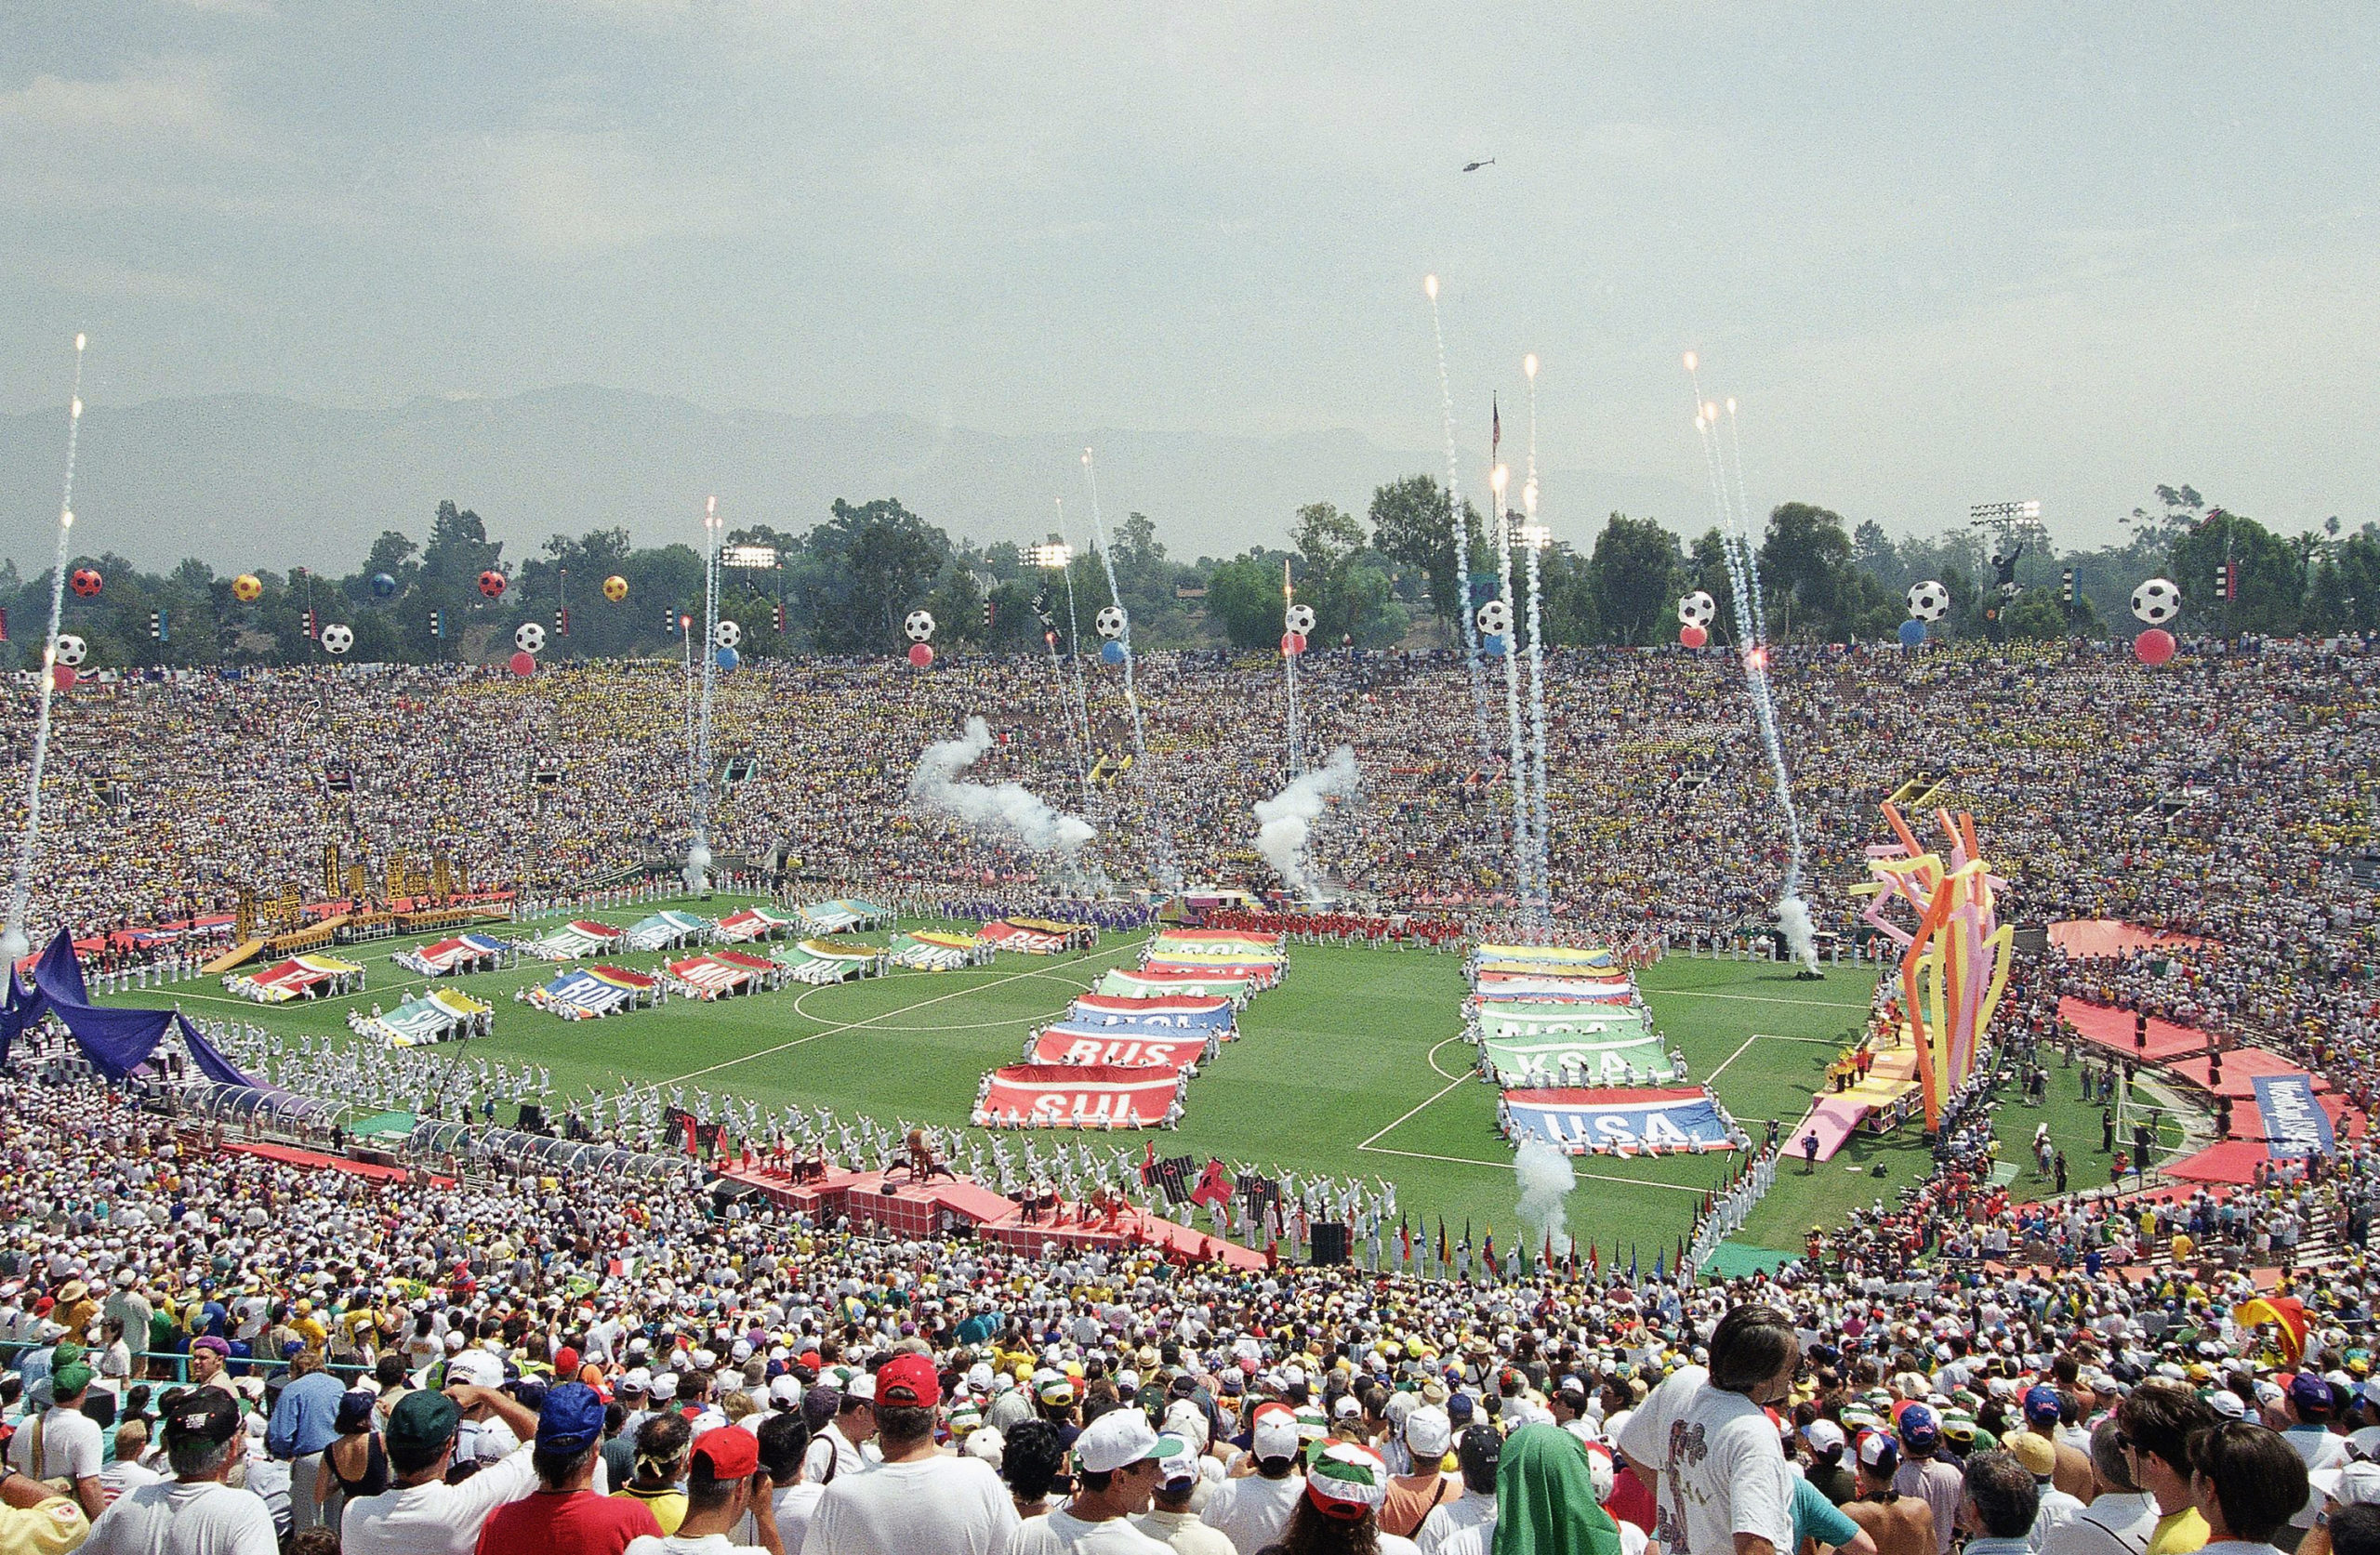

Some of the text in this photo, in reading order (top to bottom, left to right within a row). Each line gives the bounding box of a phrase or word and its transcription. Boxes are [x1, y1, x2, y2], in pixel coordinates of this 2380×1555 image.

[1065, 1039, 1176, 1067] RUS
[1035, 1093, 1131, 1119] SUI
[1543, 1113, 1688, 1144] USA
